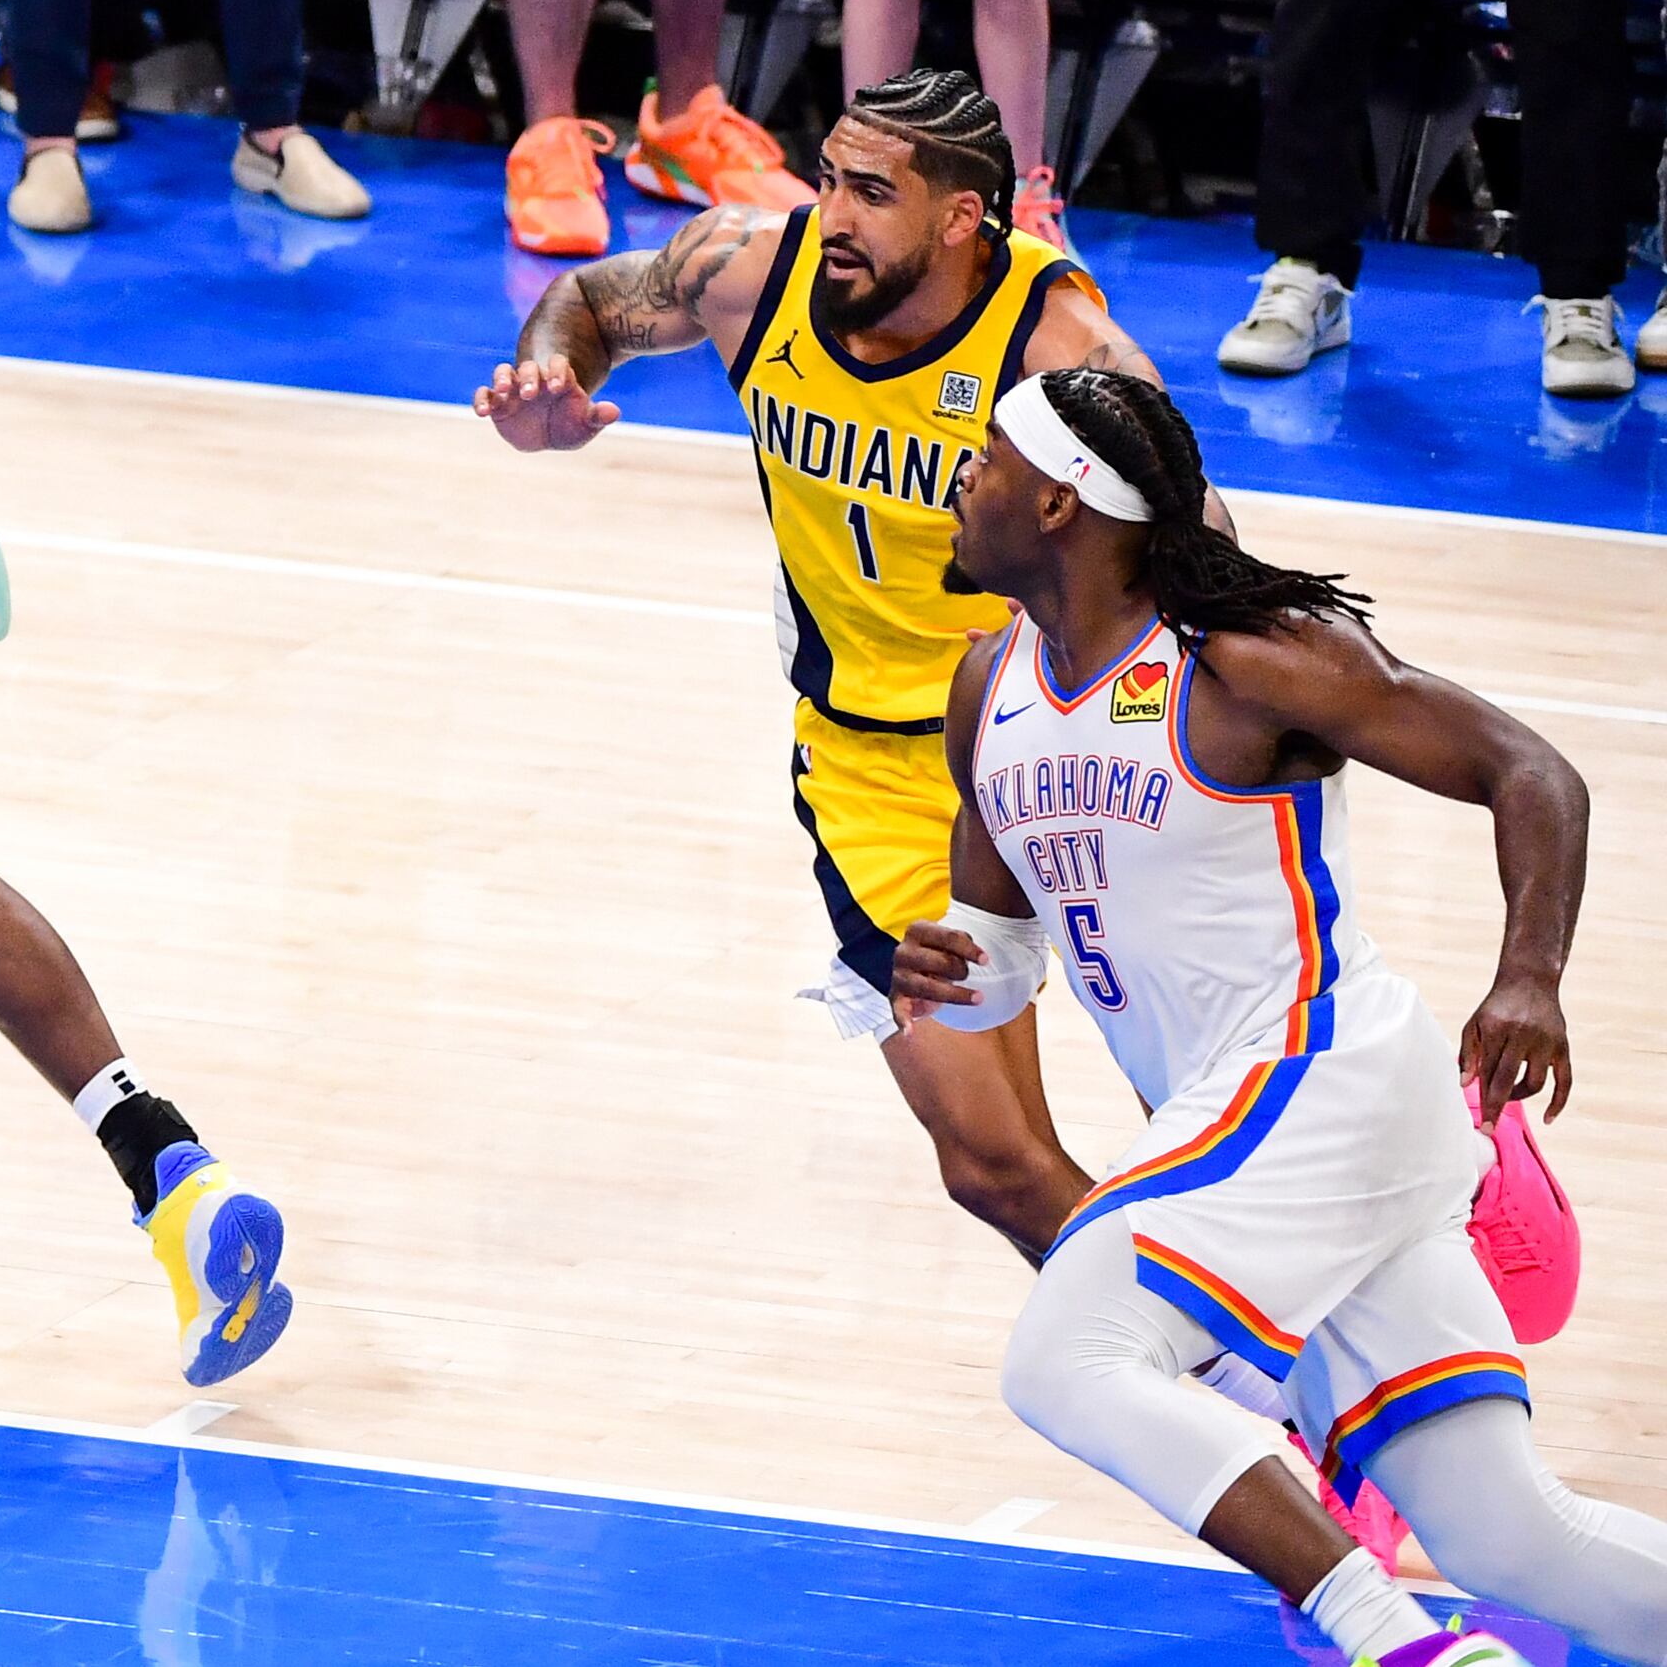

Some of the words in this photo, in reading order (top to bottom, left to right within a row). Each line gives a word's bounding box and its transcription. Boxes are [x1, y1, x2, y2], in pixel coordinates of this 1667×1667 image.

[845, 501, 879, 583] 1
[1023, 828, 1110, 893] CITY
[1059, 898, 1128, 1013] 5
